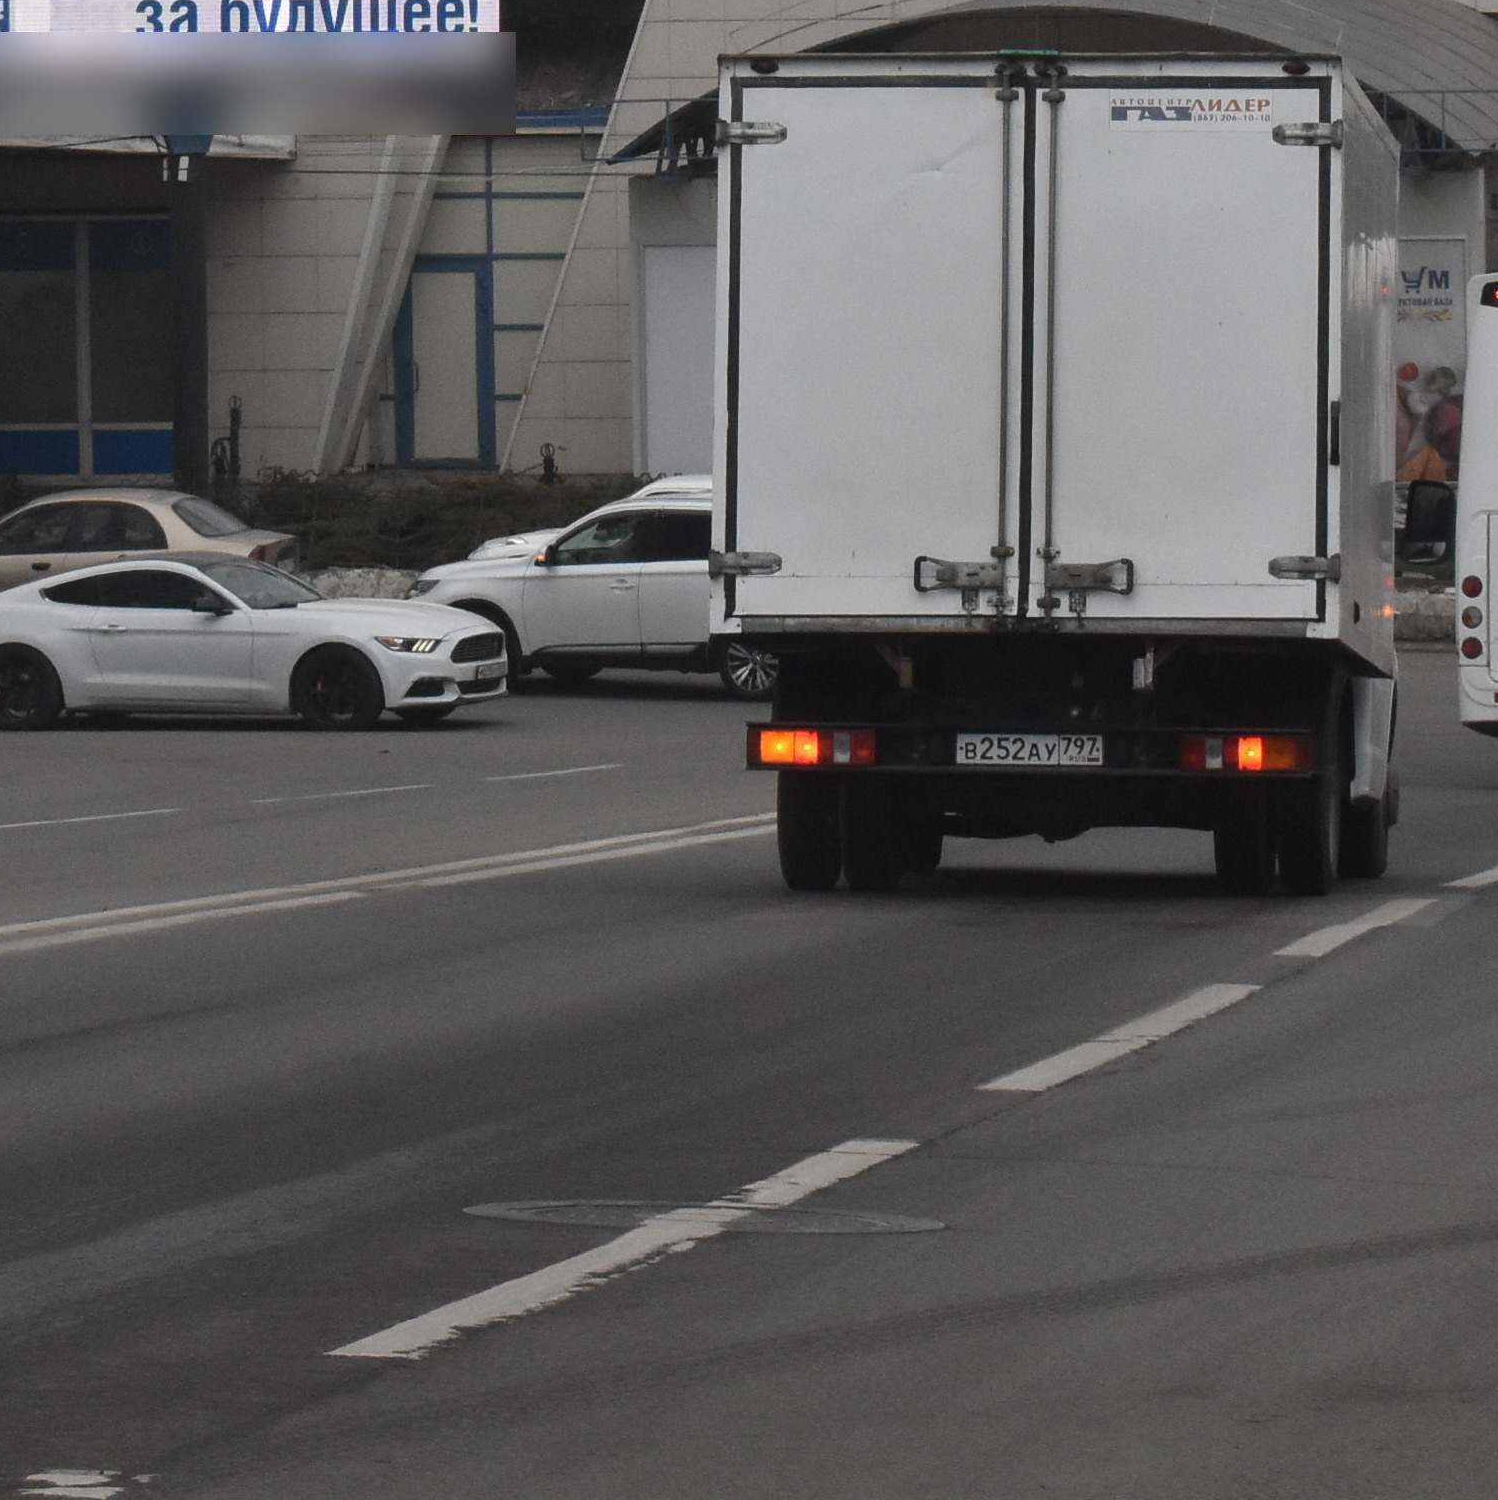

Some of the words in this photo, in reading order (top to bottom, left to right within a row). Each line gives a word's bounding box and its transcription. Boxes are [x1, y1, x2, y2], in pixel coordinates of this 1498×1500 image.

[1111, 106, 1192, 121] ГАЗ
[1191, 99, 1271, 112] ЛИДЕР
[964, 736, 1057, 761] В252АУ
[1061, 736, 1098, 755] 797
